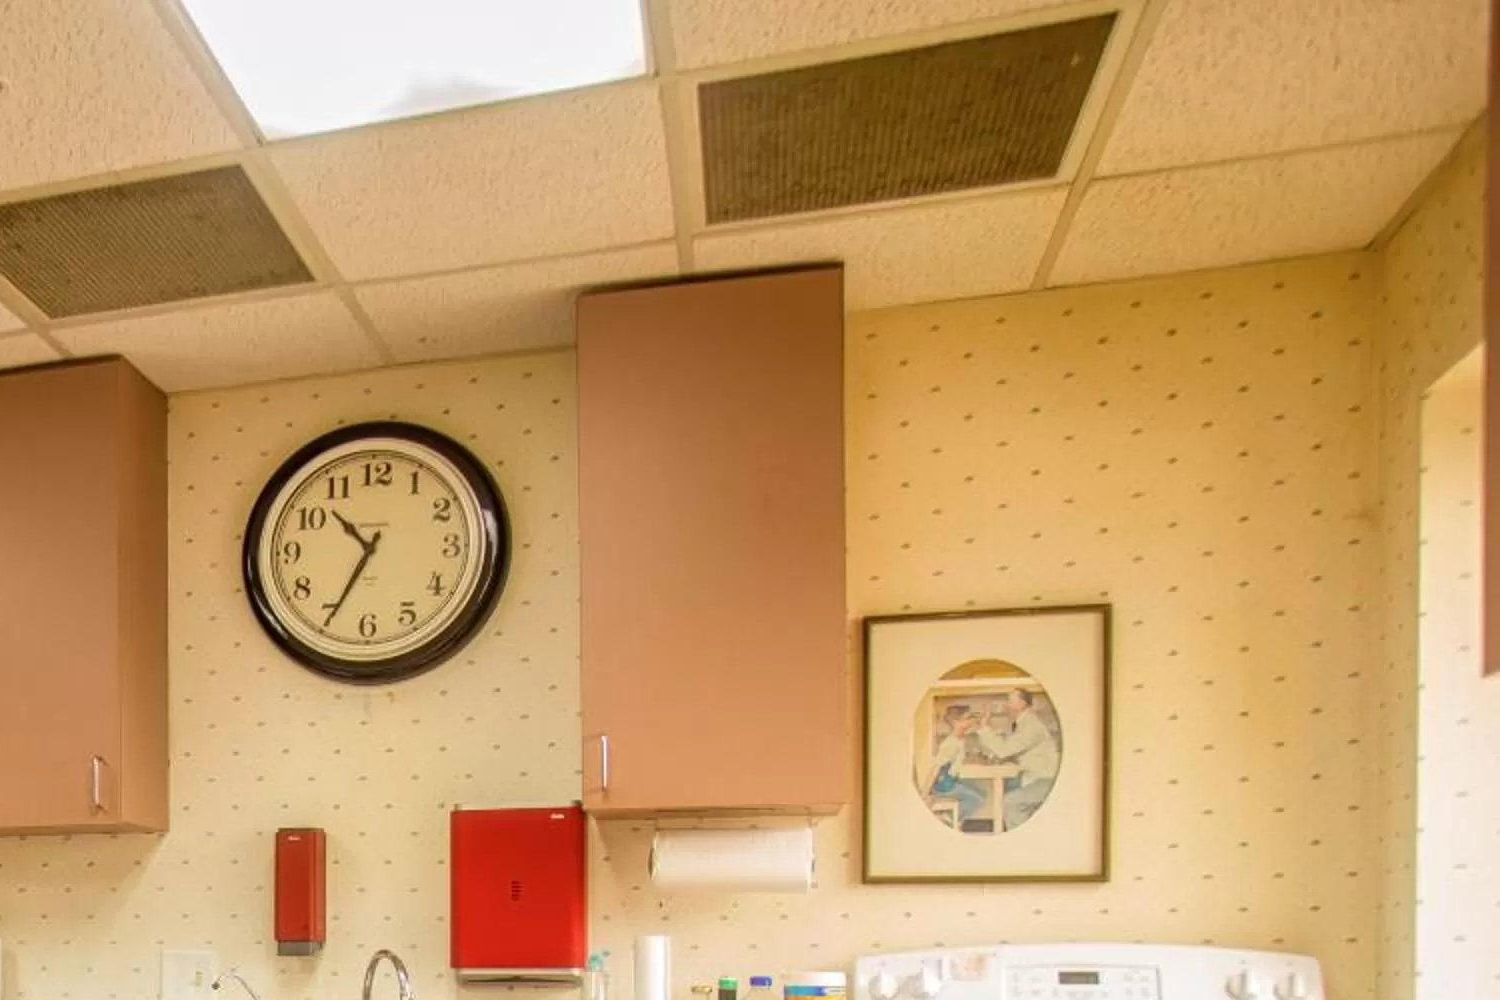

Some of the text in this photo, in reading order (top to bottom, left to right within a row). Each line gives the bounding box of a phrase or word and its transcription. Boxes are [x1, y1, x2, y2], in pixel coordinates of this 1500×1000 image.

[360, 462, 393, 486] 12
[409, 472, 420, 496] 1
[326, 476, 350, 500] 11
[297, 507, 327, 530] 10
[432, 498, 451, 522] 2
[284, 541, 301, 564] 9
[442, 534, 460, 558] 3
[293, 576, 311, 600] 8
[426, 572, 447, 597] 4
[321, 603, 342, 627] 7
[359, 614, 377, 638] 6
[398, 602, 416, 626] 5
